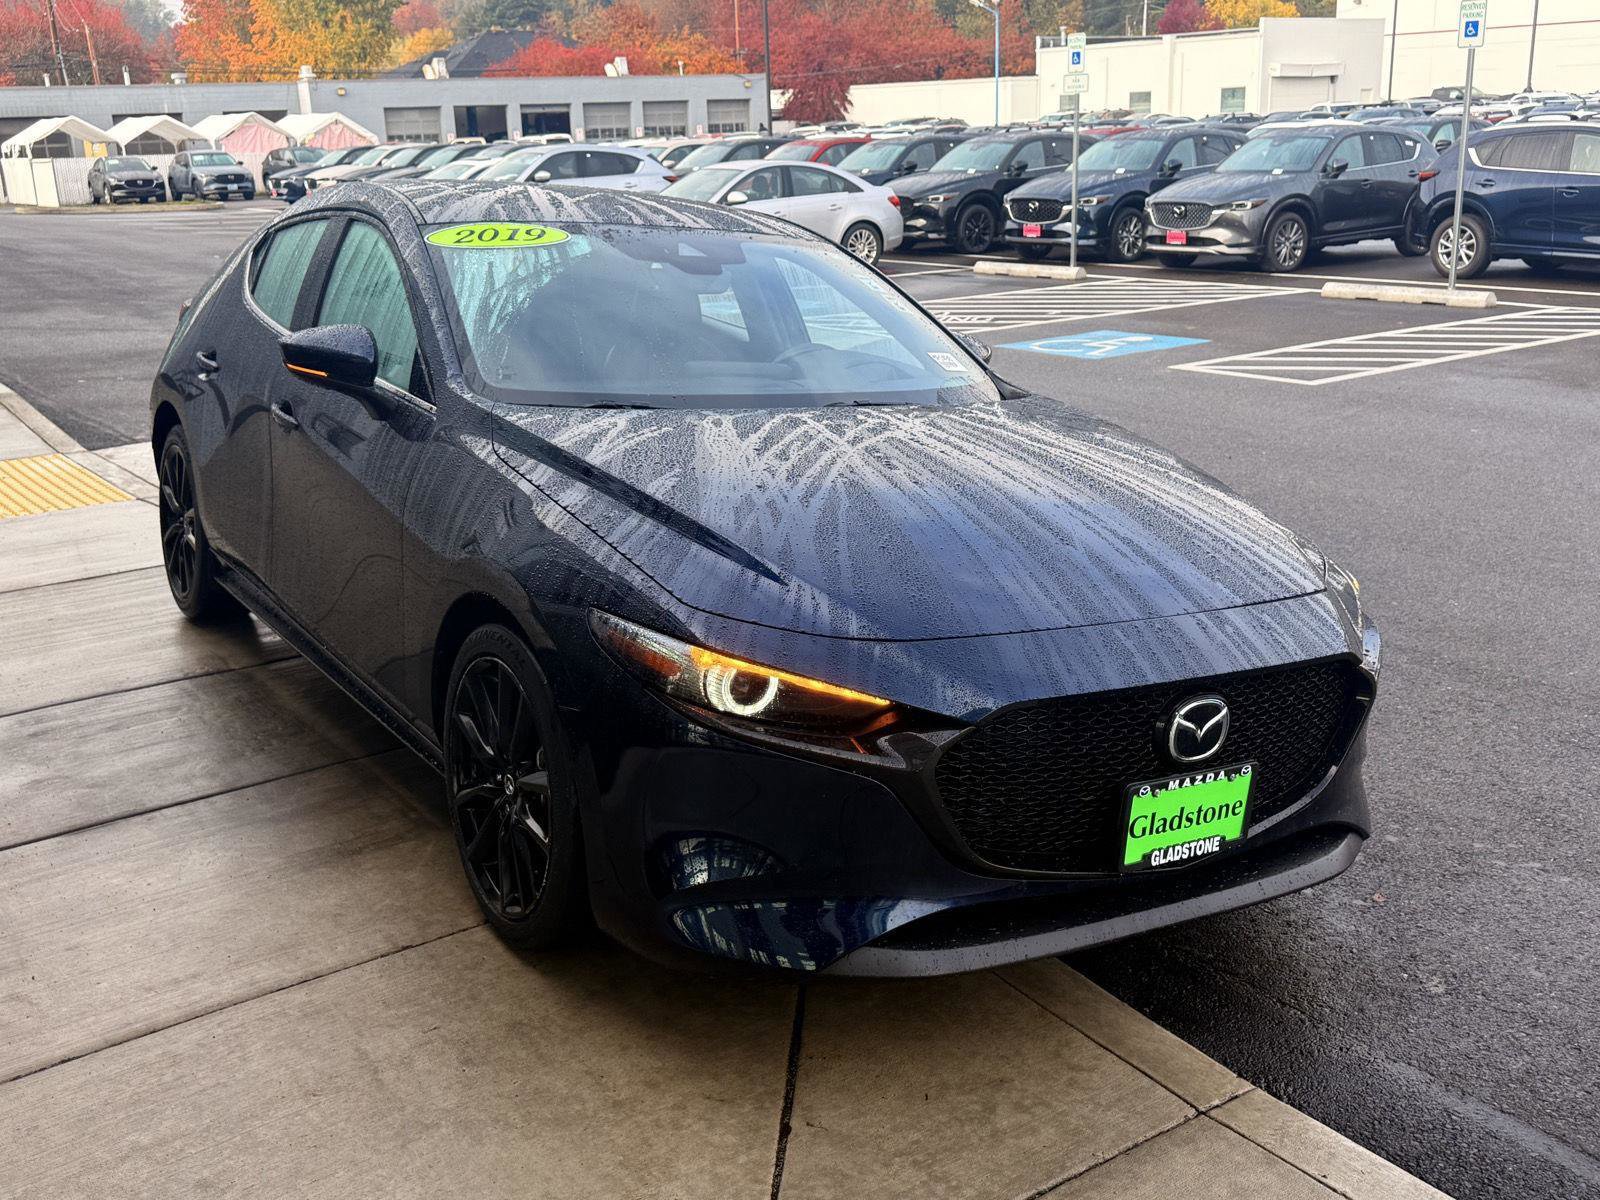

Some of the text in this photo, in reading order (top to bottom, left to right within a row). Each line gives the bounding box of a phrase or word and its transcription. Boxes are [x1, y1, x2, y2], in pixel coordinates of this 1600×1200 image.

[453, 228, 546, 244] 2019
[1167, 770, 1227, 791] MAZDA
[1129, 799, 1243, 839] Gladstone
[1150, 836, 1221, 867] GLADSTONE
